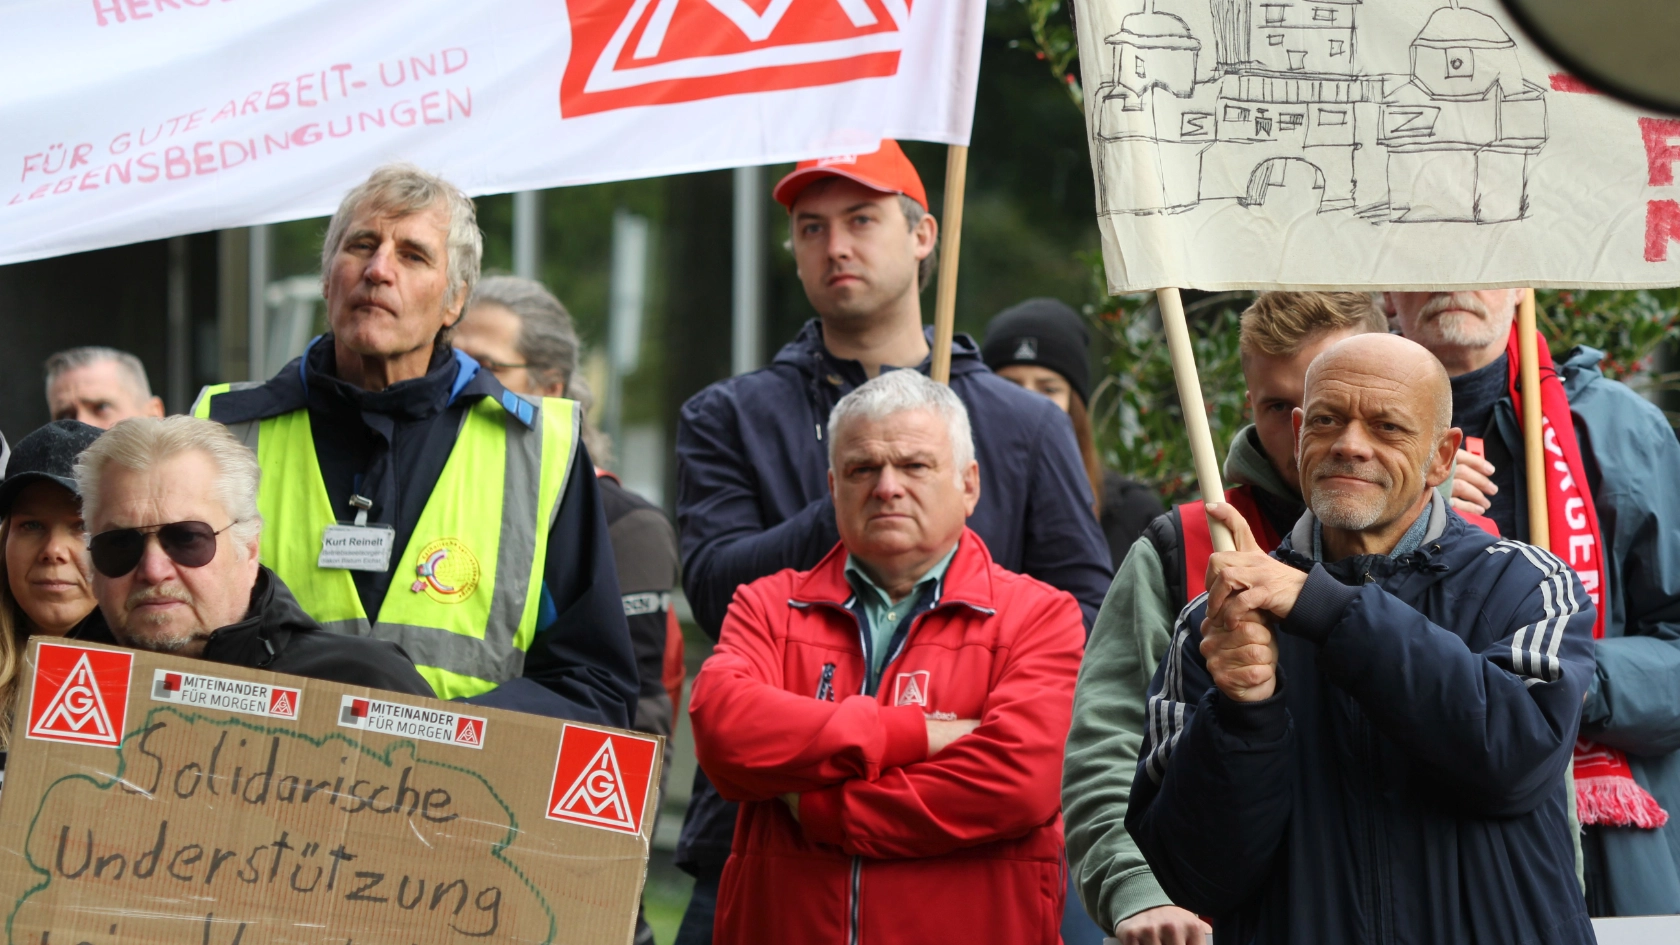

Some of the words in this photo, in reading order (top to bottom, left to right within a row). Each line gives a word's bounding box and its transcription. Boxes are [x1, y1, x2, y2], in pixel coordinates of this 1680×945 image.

[22, 142, 94, 183] FÜR
[109, 107, 207, 155] GUTE
[211, 63, 367, 124] ARBEIT-
[379, 47, 468, 88] UND
[7, 87, 472, 206] LEBENSBEDINGUNGEN
[325, 537, 346, 546] Kurt
[349, 537, 383, 546] Reinelt
[183, 676, 267, 698] MITEINANDER
[181, 688, 206, 704] FÜR
[210, 694, 266, 713] MORGEN
[370, 702, 454, 727] MITEINANDER
[368, 716, 394, 731] FÜR
[396, 721, 452, 741] MORGEN
[120, 721, 459, 823] Solidarische
[55, 820, 501, 937] Understützung
